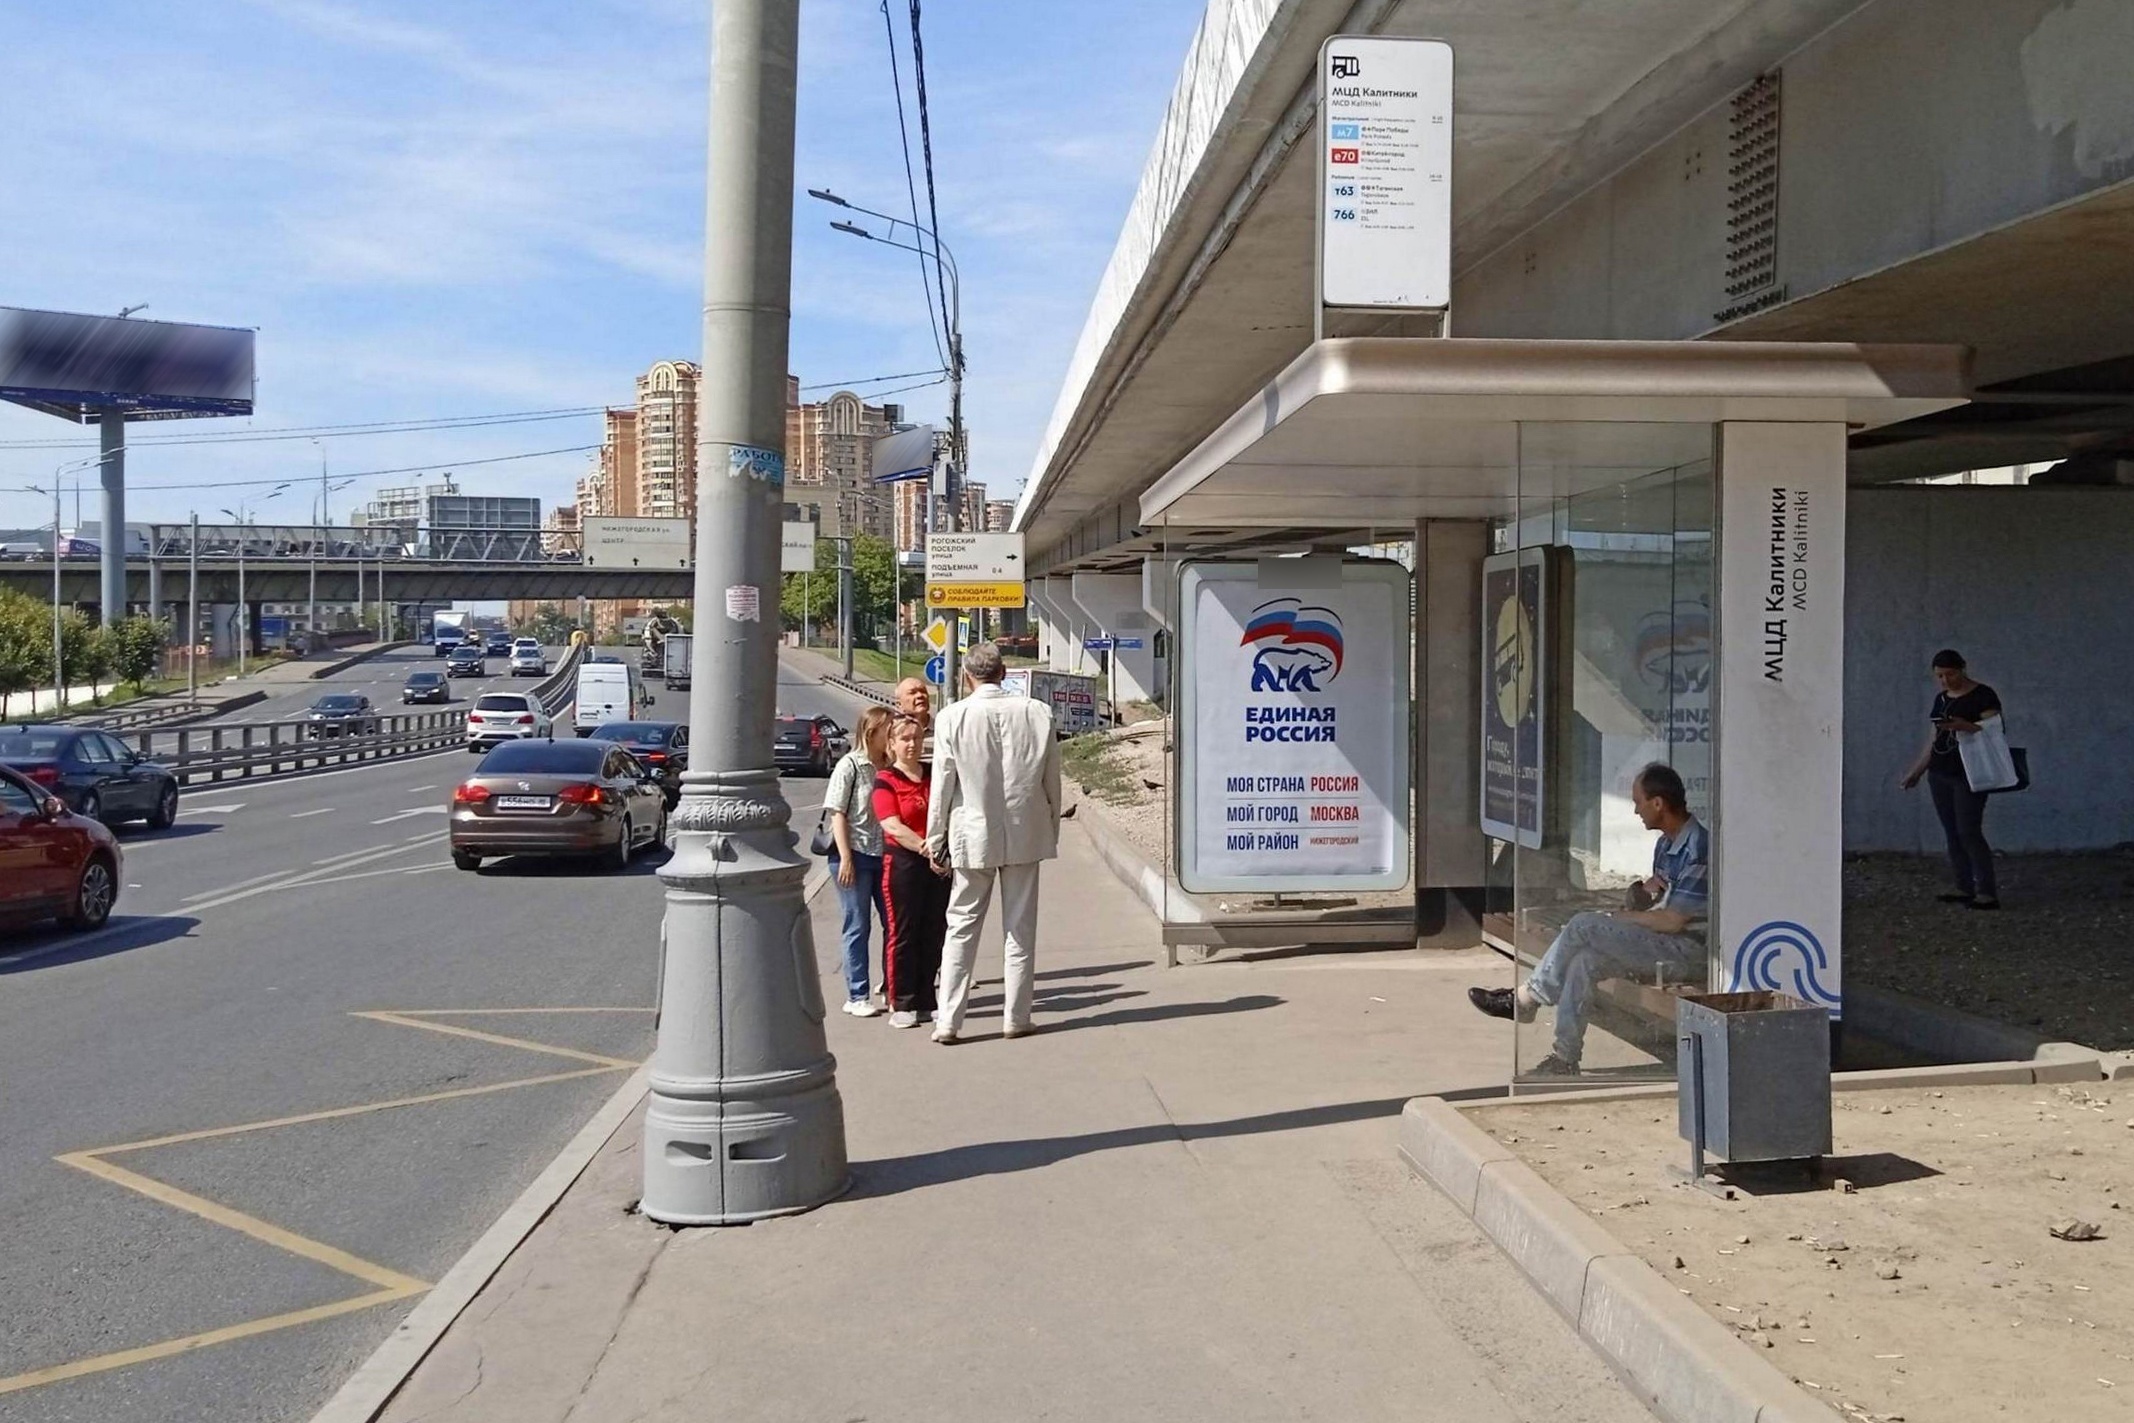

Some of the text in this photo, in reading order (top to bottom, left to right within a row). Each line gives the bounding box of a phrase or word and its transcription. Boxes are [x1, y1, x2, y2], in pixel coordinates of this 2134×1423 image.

[1331, 87, 1418, 99] МЦД Калитники
[1334, 209, 1355, 220] 766
[1793, 491, 1808, 611] MCD Kalitniki
[947, 587, 996, 595] СОБЛЮДАЙТЕ
[1764, 487, 1787, 683] МЦД Калитники
[1246, 707, 1336, 724] ЕДИНАЯ
[1246, 726, 1336, 742] РОССИЯ
[1227, 776, 1359, 792] МОЯ СТРАНА РОССИЯ
[1227, 803, 1359, 824] МОЙ ГОРОД МОСКВА
[1227, 832, 1359, 851] МОЙ РАЙОН НИЖЕГОРОДСКИЙ
